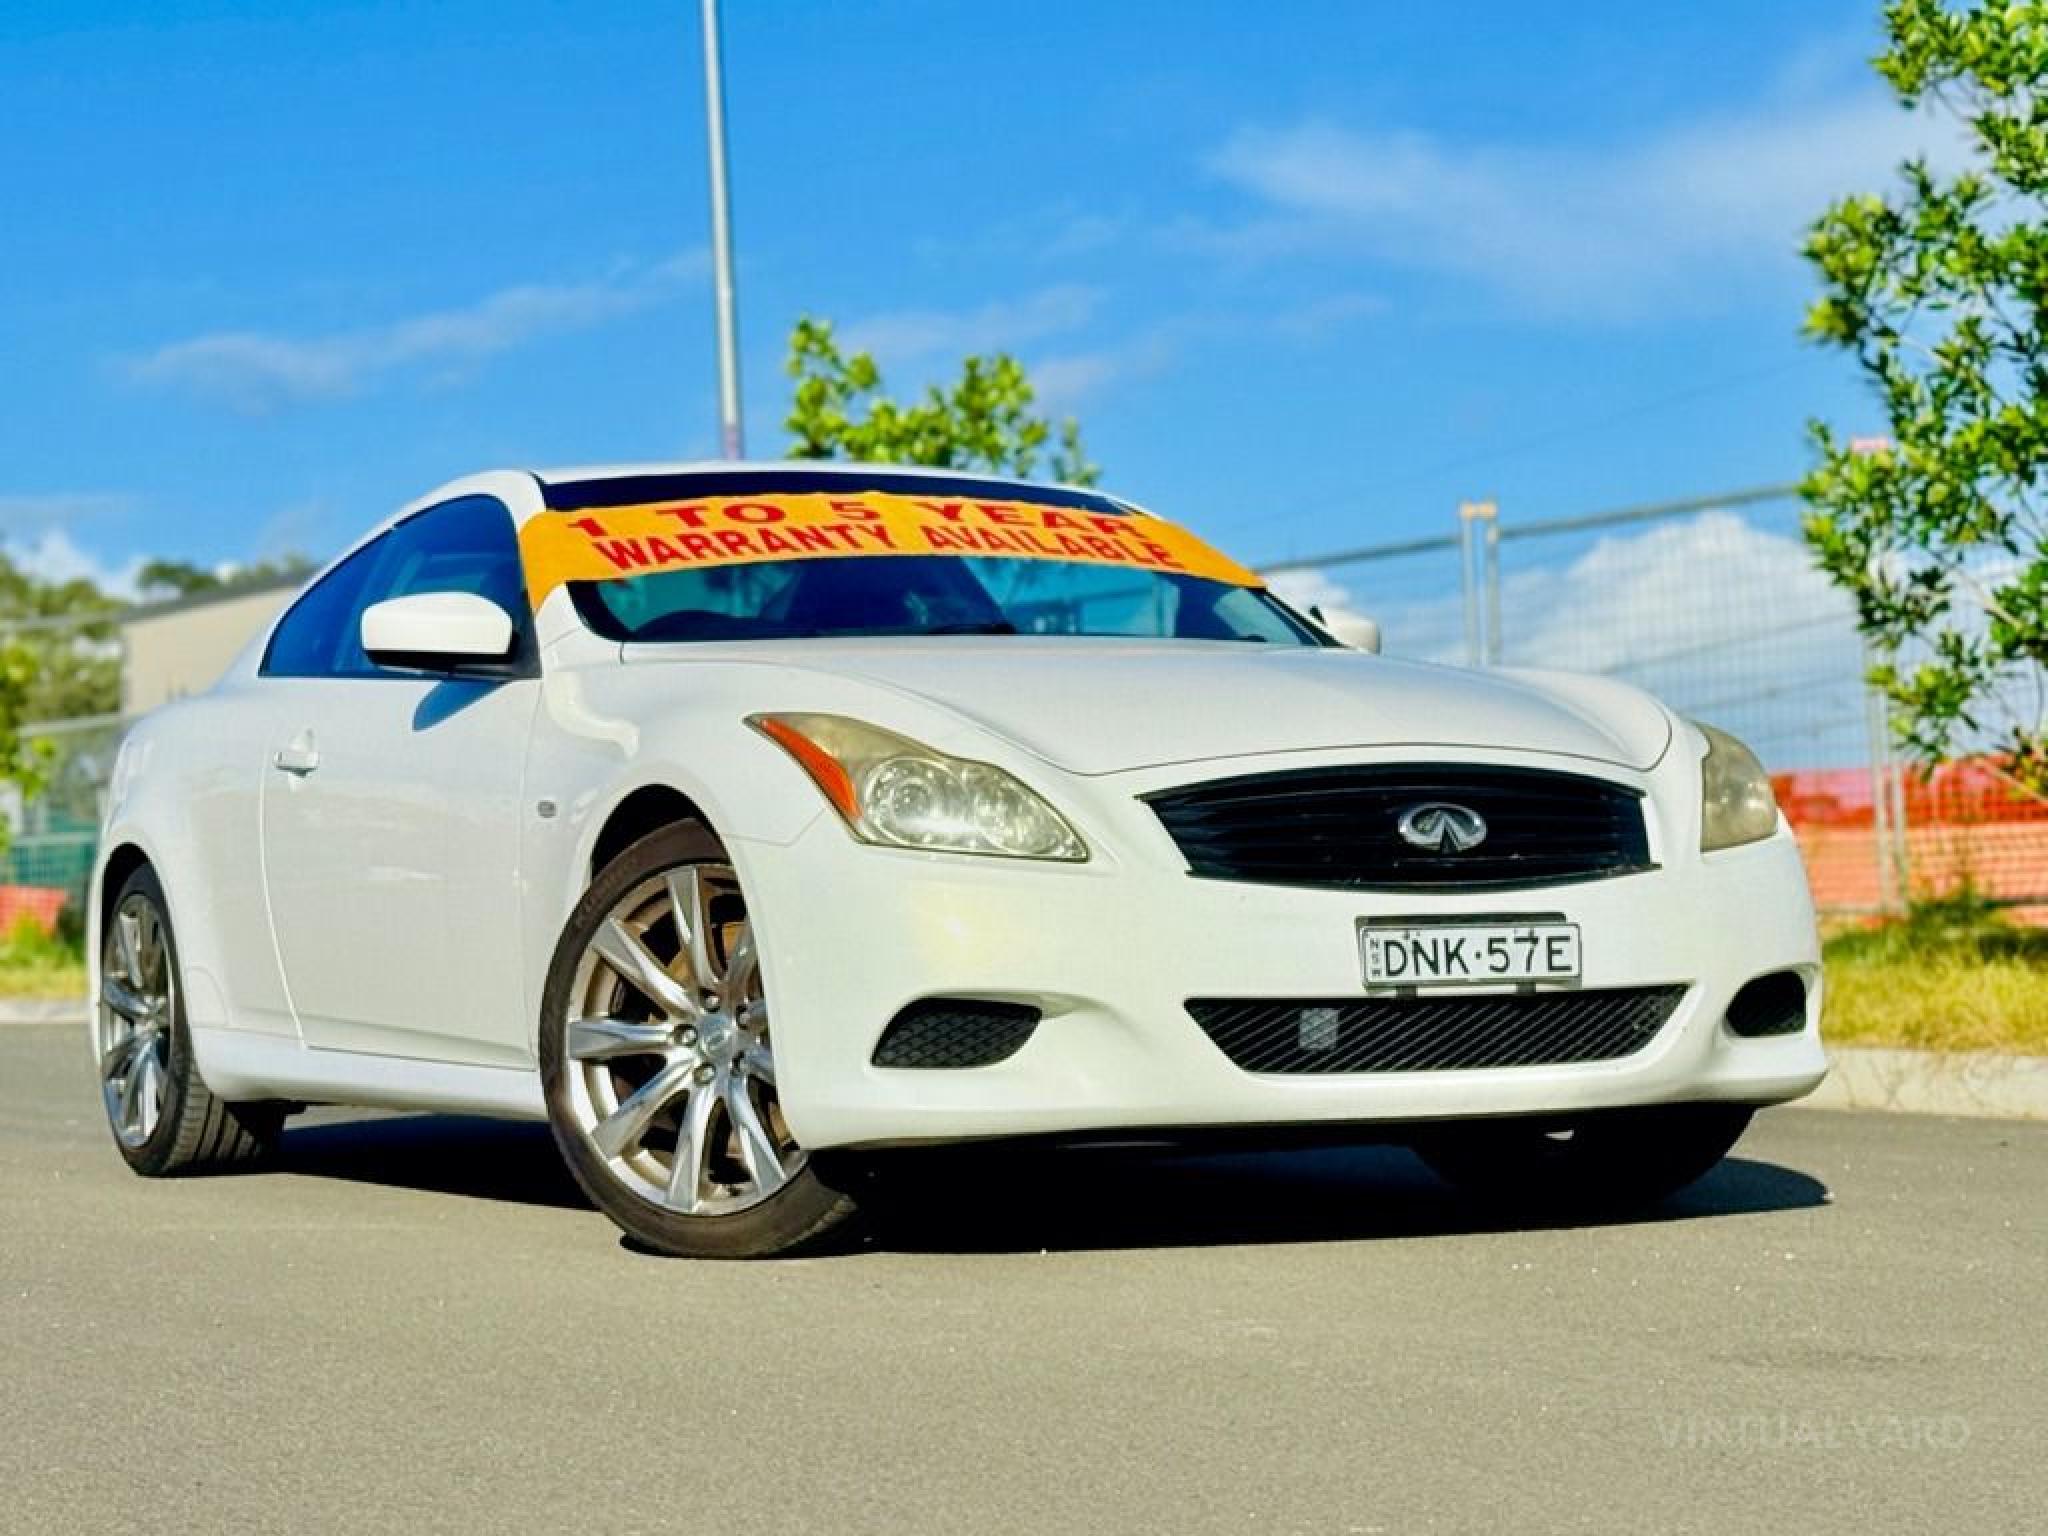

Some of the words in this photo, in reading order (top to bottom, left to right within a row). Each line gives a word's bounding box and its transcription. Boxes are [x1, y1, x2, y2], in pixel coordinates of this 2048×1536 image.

[568, 517, 609, 537] 1
[655, 503, 787, 529] TO
[829, 501, 882, 521] 5
[592, 523, 897, 571] WARRANTY
[920, 525, 1186, 570] AVAILABLE
